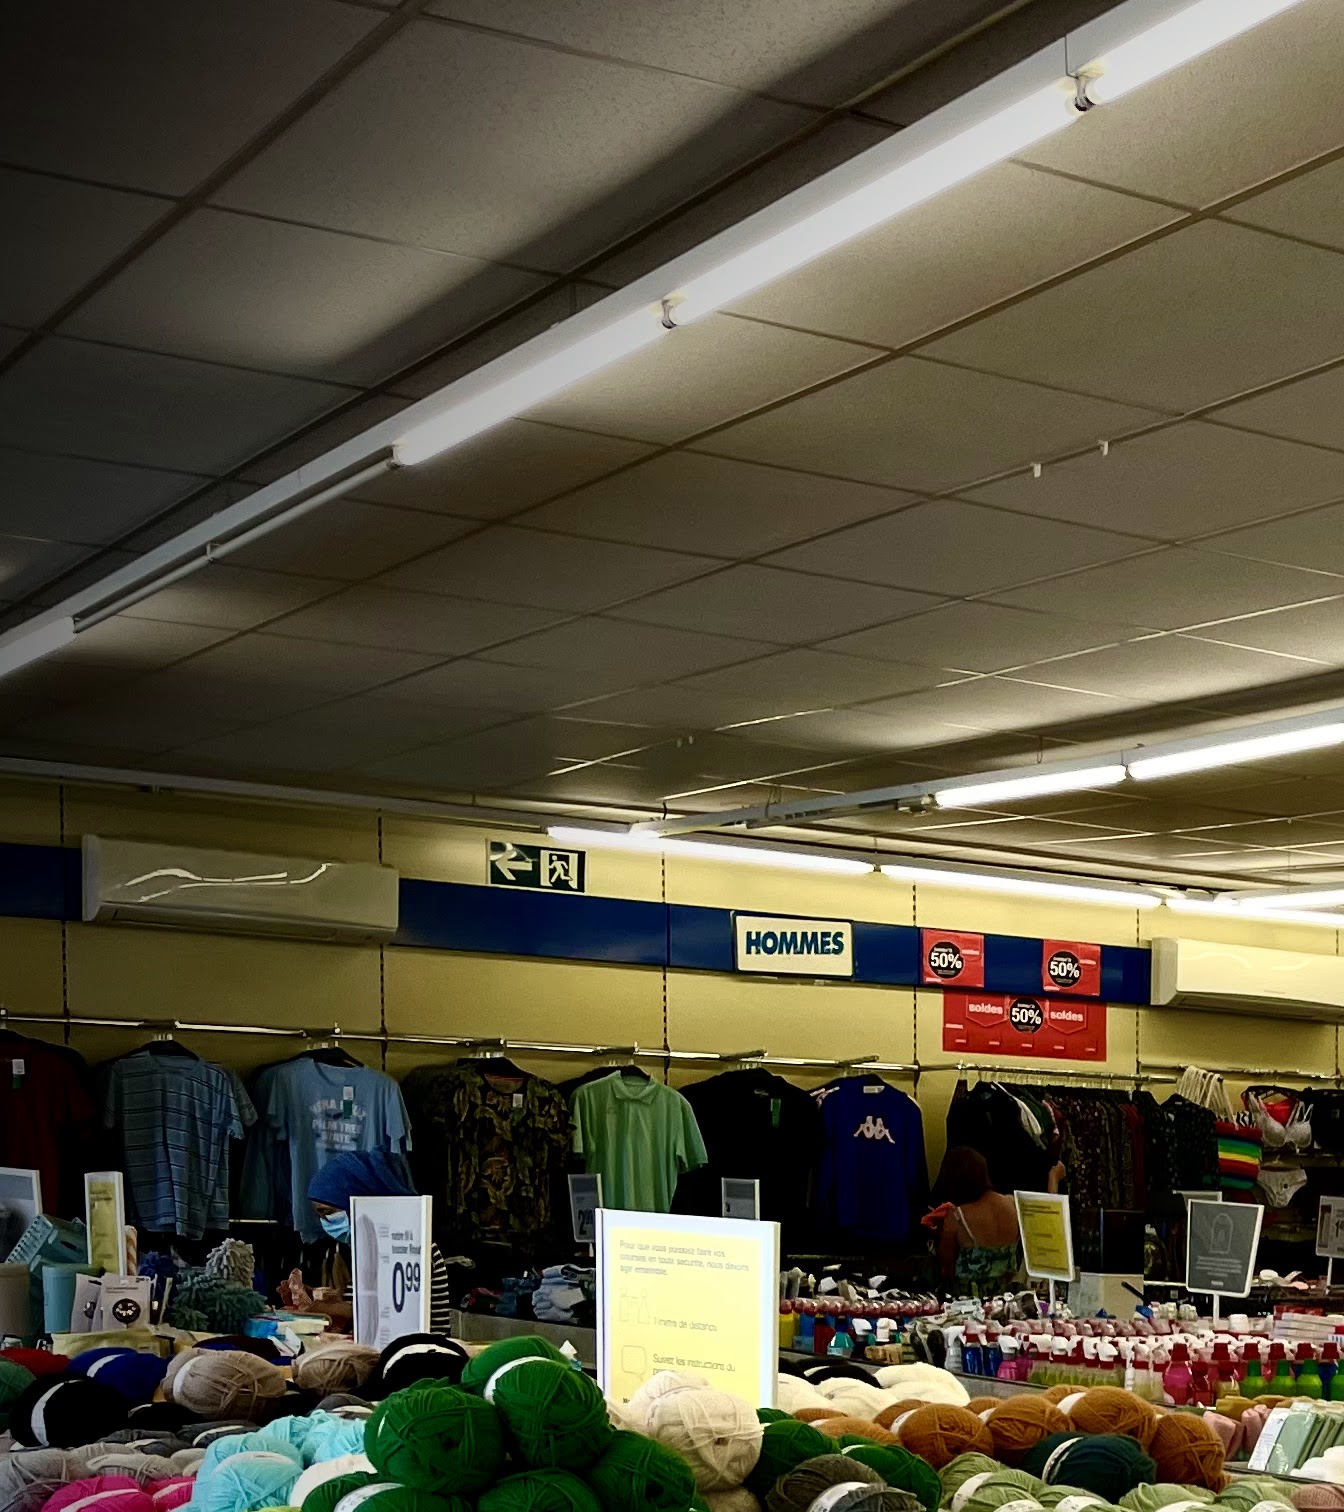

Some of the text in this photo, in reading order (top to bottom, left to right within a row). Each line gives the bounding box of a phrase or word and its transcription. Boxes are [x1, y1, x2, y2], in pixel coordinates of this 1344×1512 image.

[746, 931, 844, 955] HOMMES
[930, 952, 962, 969] 50%
[1050, 961, 1080, 978] 50%
[969, 1003, 1083, 1025] soldes 50% soldes
